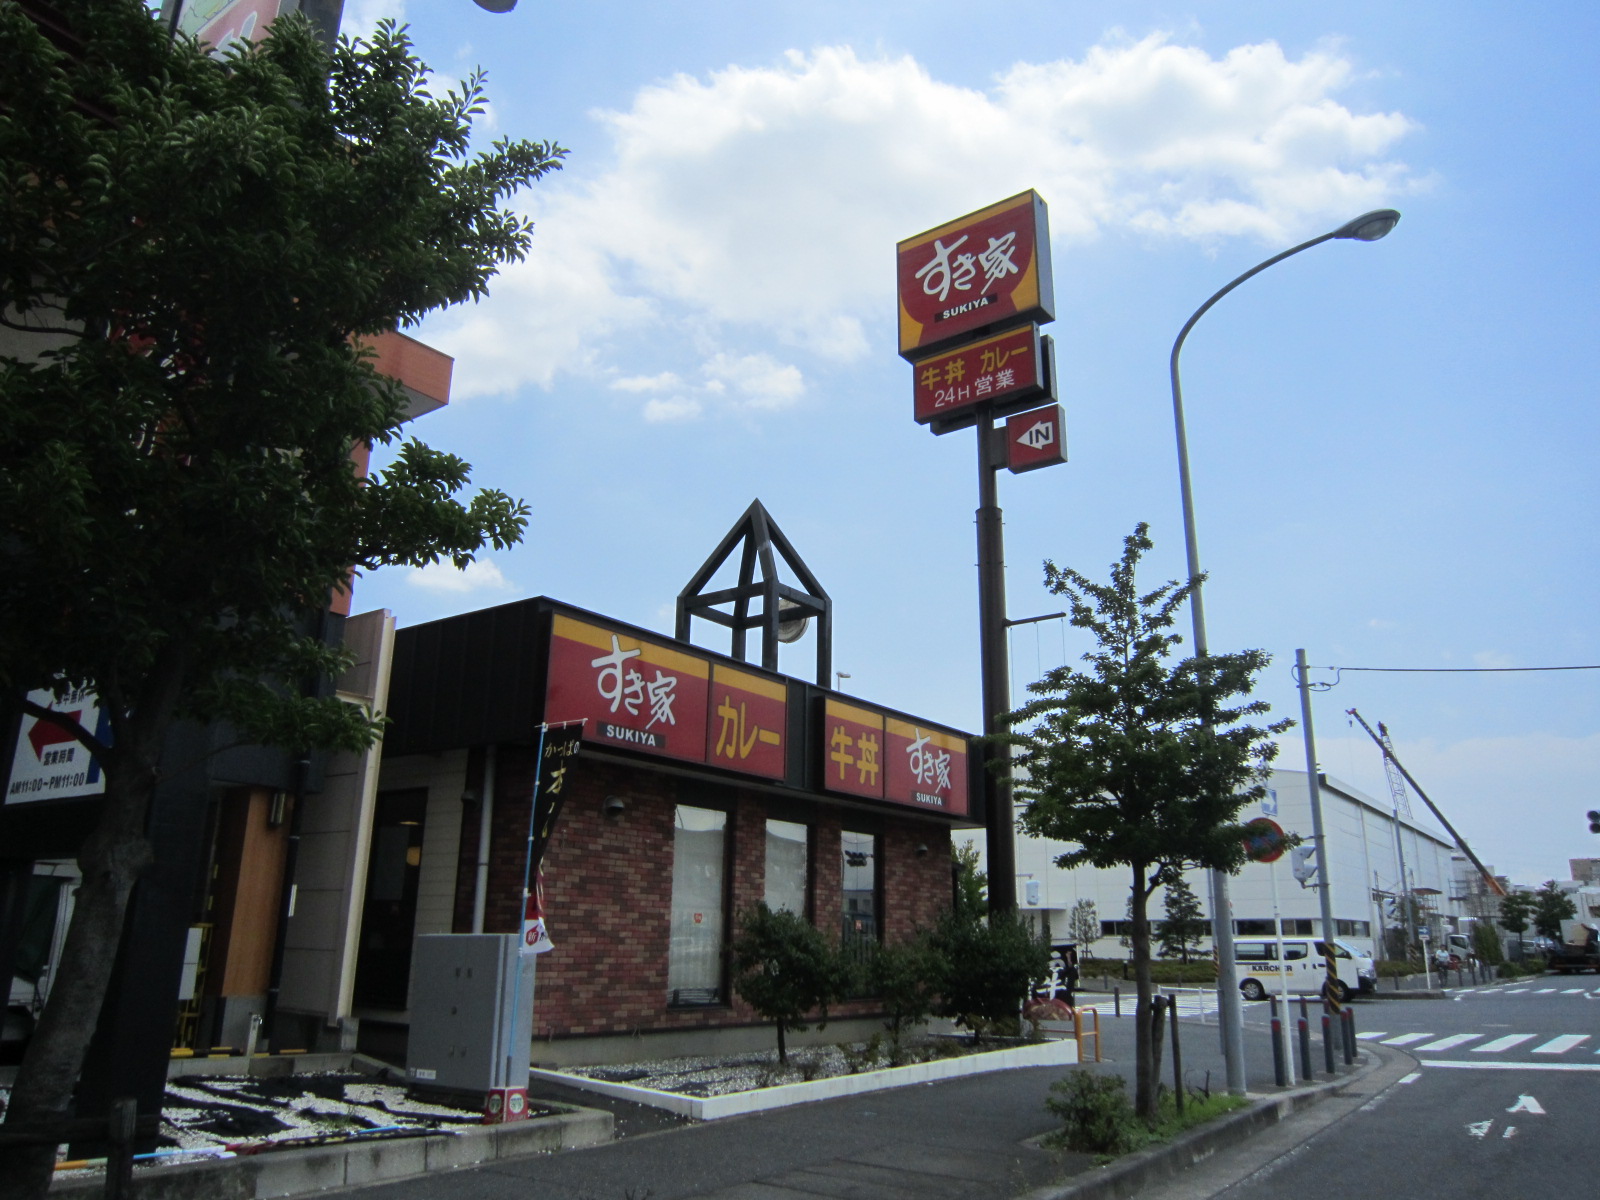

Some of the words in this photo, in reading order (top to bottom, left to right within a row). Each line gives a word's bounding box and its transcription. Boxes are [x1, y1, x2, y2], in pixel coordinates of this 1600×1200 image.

[915, 231, 1019, 301] すき家
[943, 297, 989, 319] SUKIYA
[921, 358, 966, 390] 牛丼
[980, 346, 1028, 374] カレー
[1029, 426, 1049, 445] IN
[591, 634, 677, 730] すき家
[606, 724, 656, 747] SUKIYA
[716, 695, 781, 759] カレー
[43, 747, 75, 766] 営業時間
[830, 725, 879, 786] 牛丼
[906, 728, 951, 793] すき家
[916, 792, 942, 806] SUKIYA
